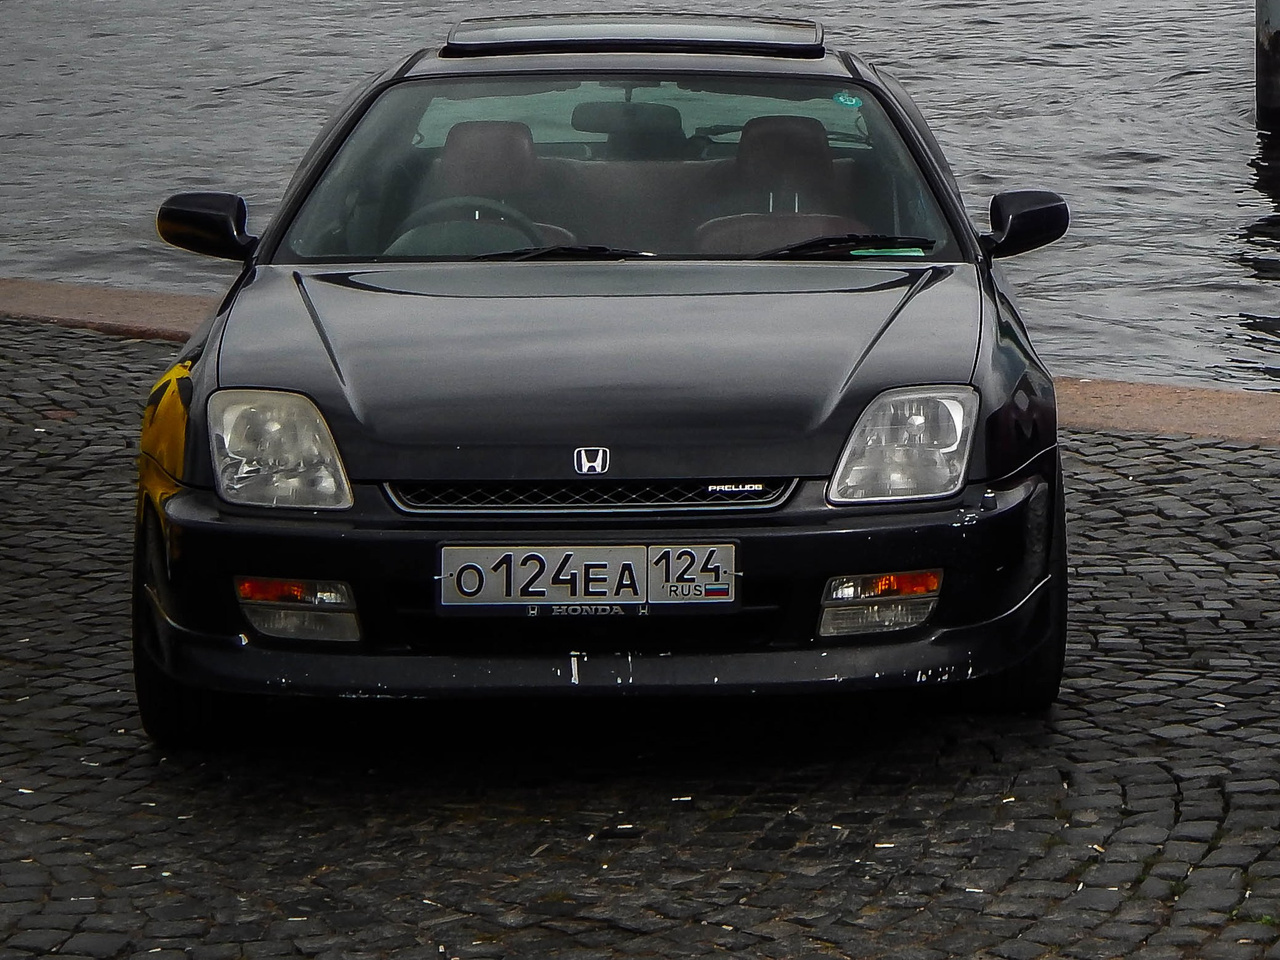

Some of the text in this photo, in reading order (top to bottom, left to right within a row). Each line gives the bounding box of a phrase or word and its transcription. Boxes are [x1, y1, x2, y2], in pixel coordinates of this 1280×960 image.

[708, 484, 763, 492] PRELUDE
[653, 548, 721, 583] 124
[668, 584, 703, 597] RUS
[551, 605, 625, 616] HONDA
